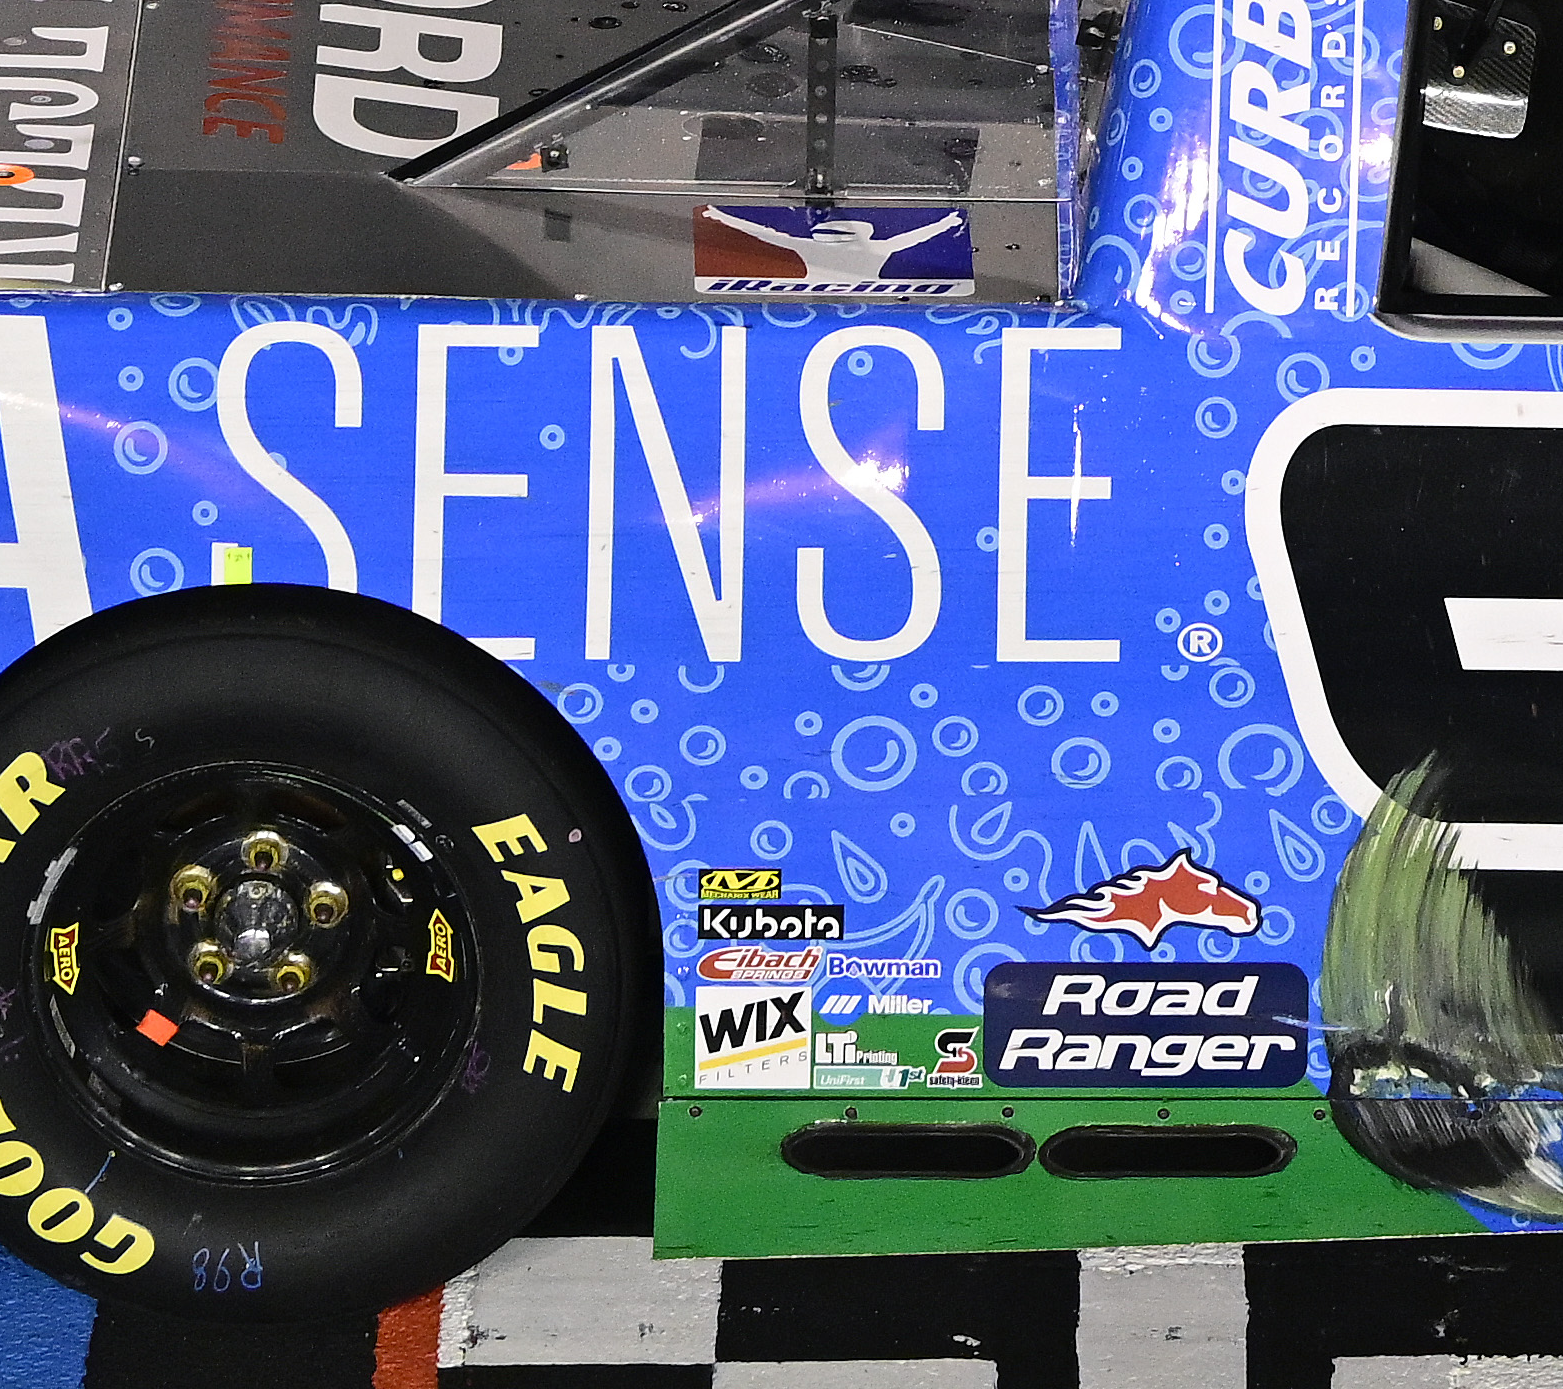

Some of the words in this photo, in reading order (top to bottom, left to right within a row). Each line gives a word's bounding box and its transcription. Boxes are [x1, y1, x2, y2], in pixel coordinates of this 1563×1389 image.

[706, 278, 958, 295] iRacing
[211, 321, 1121, 662] SENSE
[703, 908, 840, 939] Kubota
[57, 934, 73, 982] AERO
[473, 812, 590, 1094] EAGLE
[699, 946, 821, 978] Eibach
[828, 958, 938, 976] Bowman
[868, 994, 932, 1014] Miller
[1042, 974, 1259, 1016] Road
[699, 991, 806, 1054] WIX
[699, 1050, 808, 1085] FILTERS
[999, 1029, 1296, 1077] Ranger
[191, 1240, 263, 1292] R98
